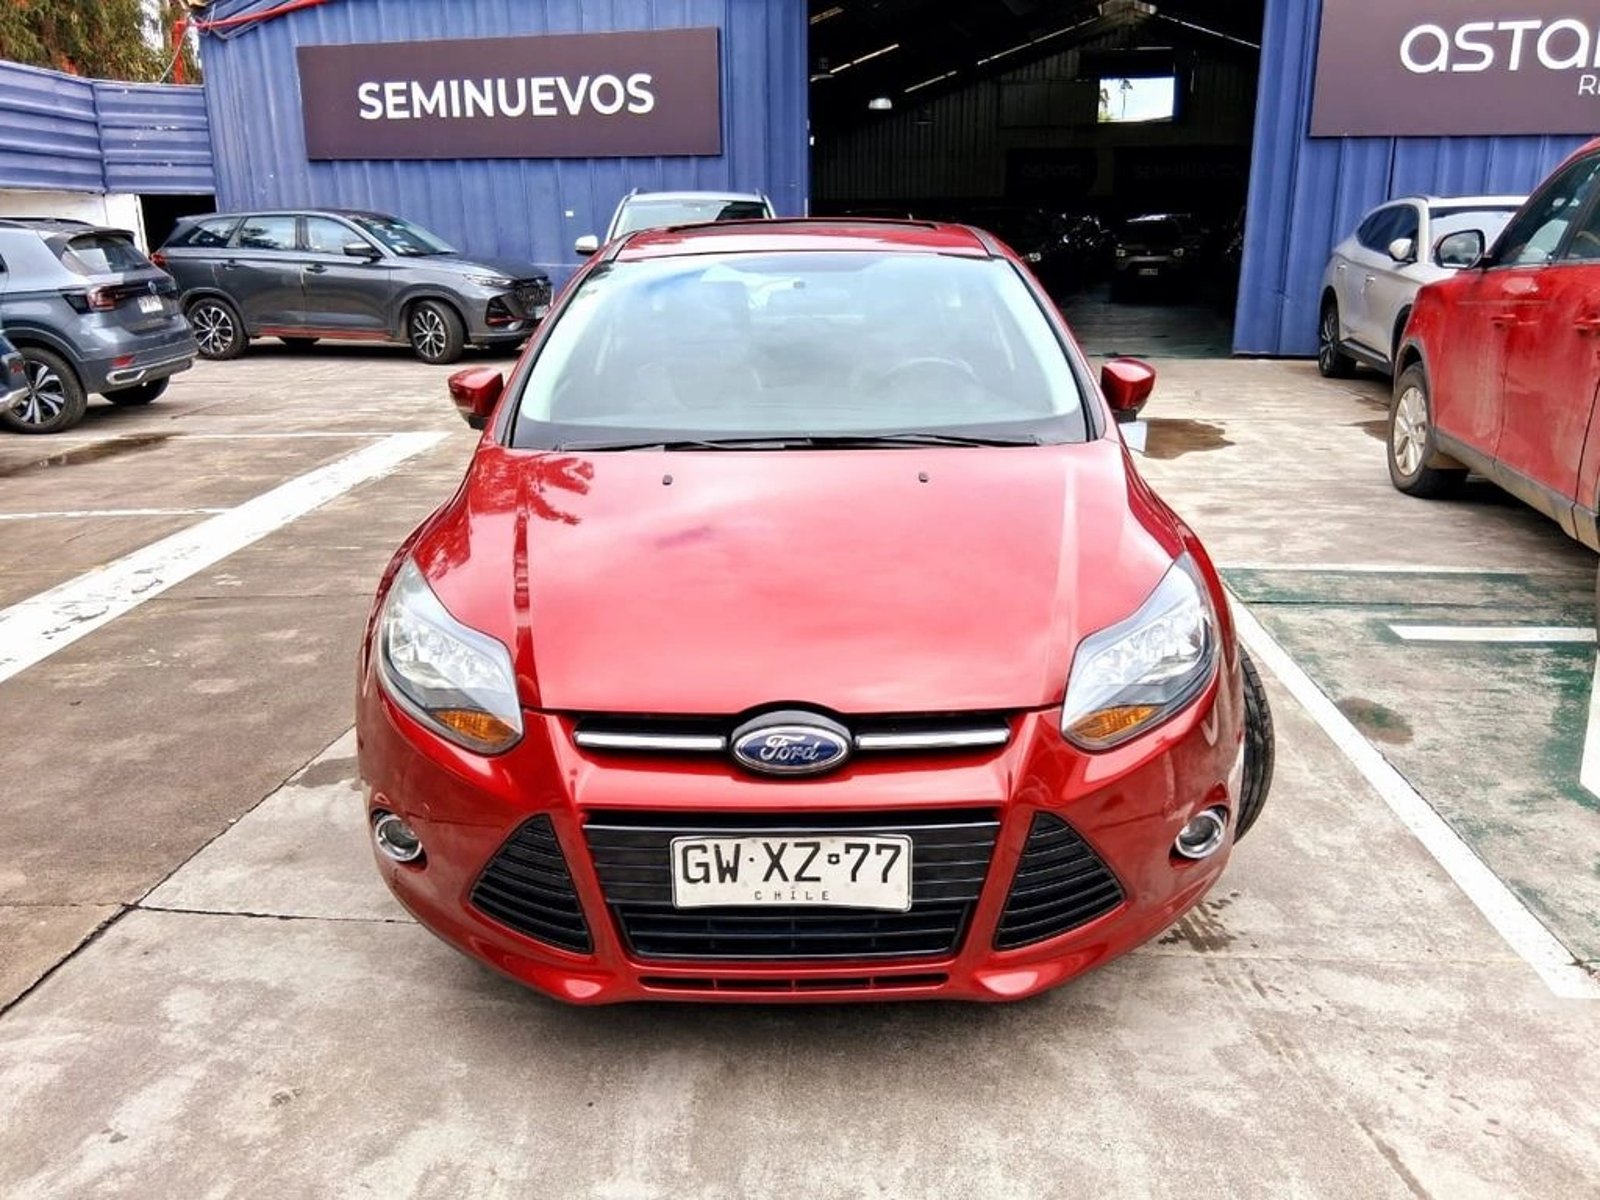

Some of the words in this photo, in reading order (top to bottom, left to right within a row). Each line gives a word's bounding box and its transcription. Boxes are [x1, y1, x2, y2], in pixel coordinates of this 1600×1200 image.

[357, 73, 655, 120] SEMINUEVOS
[1578, 74, 1600, 96] R
[760, 734, 820, 761] Ford
[754, 890, 830, 901] CHILE
